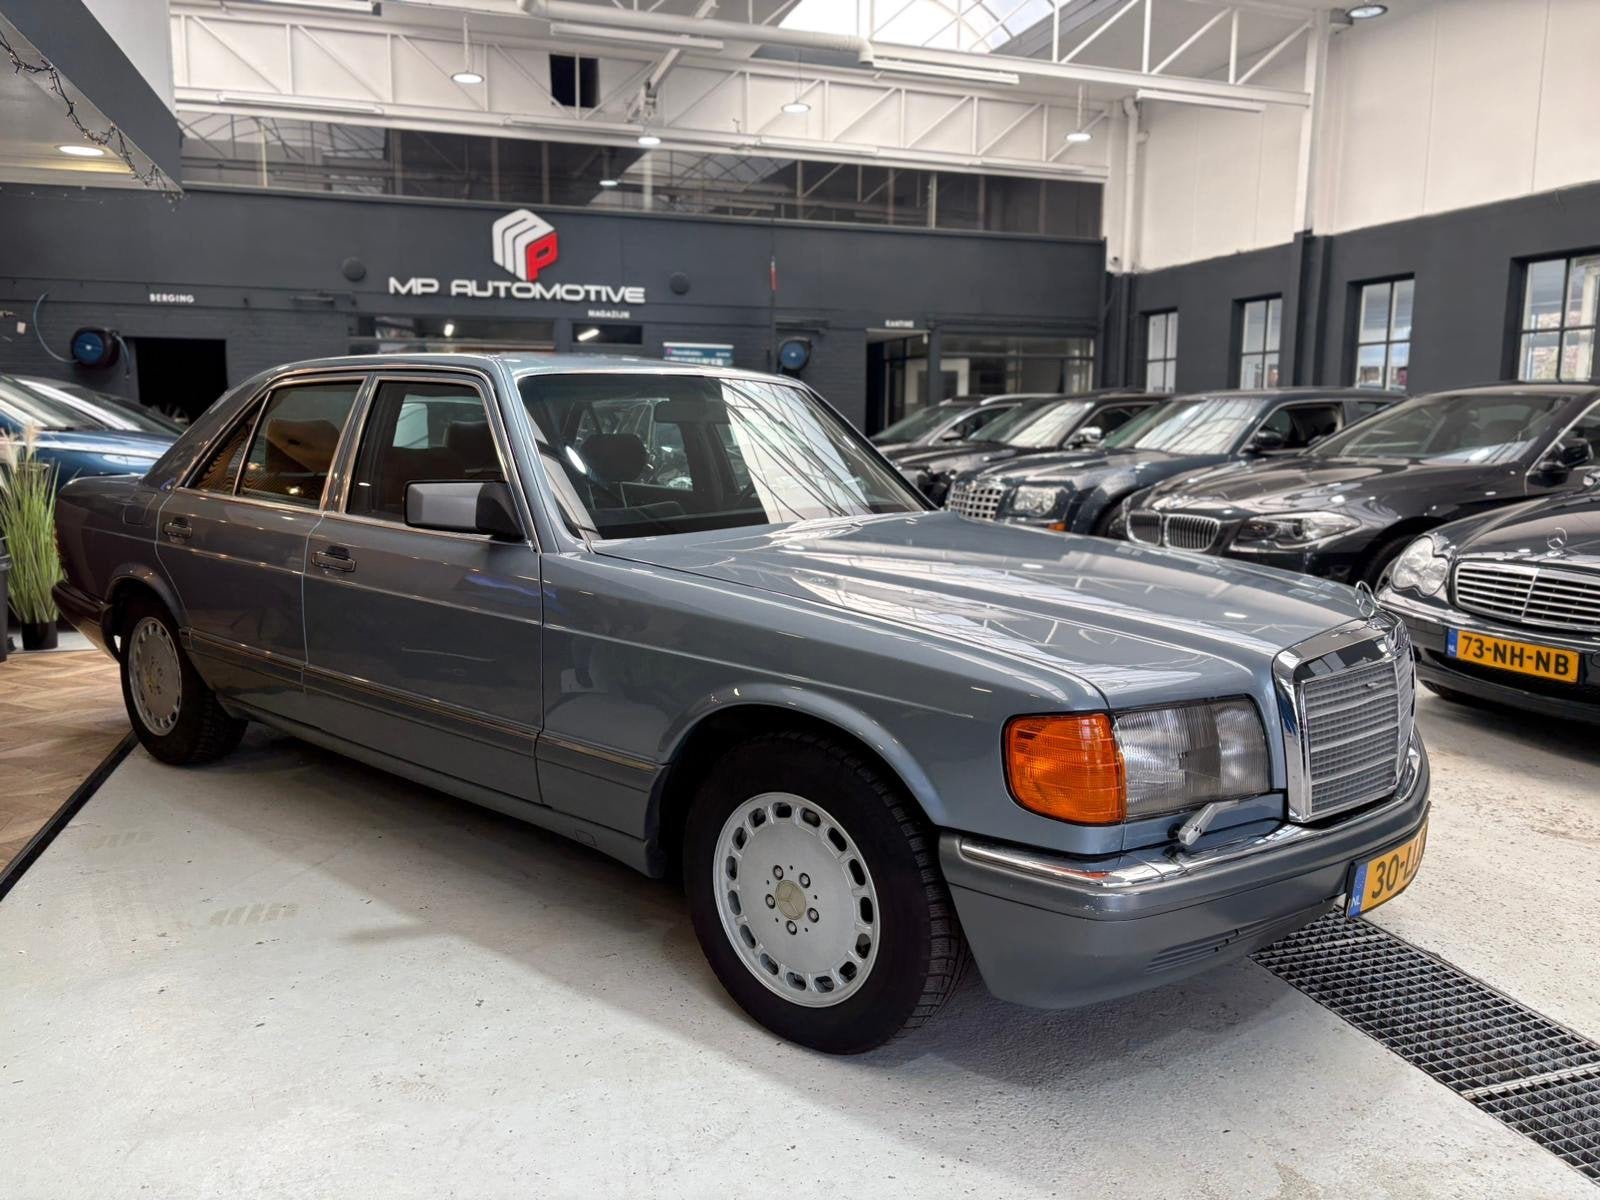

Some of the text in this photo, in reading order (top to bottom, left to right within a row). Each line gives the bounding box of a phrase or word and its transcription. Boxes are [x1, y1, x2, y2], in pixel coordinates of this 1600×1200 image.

[149, 293, 194, 303] BERGING
[388, 276, 646, 304] MP AUTOMOTIVE
[1461, 635, 1570, 676] 73-NH-NB
[1350, 895, 1361, 908] NL
